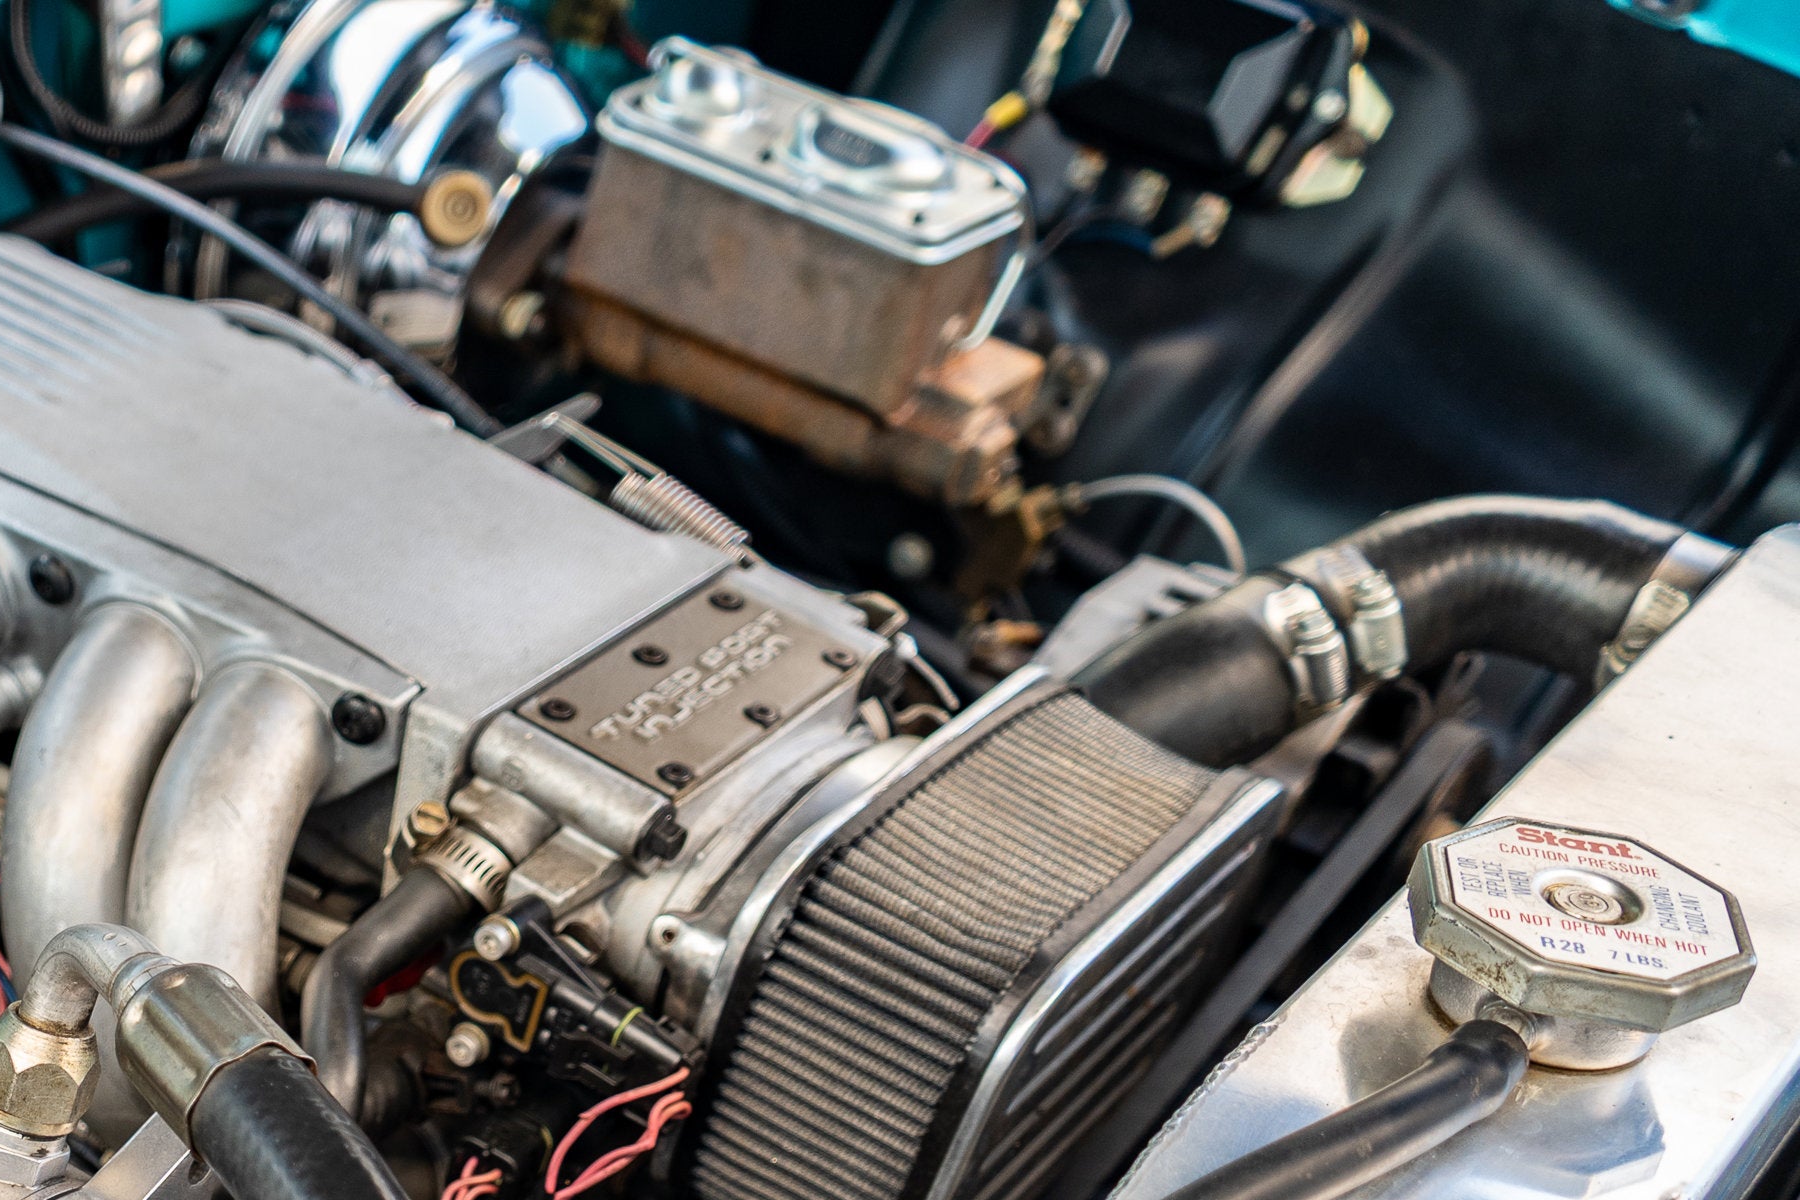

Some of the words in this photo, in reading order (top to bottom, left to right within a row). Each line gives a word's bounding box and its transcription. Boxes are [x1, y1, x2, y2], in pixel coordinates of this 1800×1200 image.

[589, 665, 703, 742] TUNED
[1499, 842, 1570, 863] CAUTION
[1577, 855, 1661, 879] PRESSURE
[1515, 827, 1633, 859] Stant
[1457, 857, 1479, 869] OR
[1460, 870, 1483, 893] TEST
[1482, 860, 1509, 899] REPLACE
[1508, 869, 1532, 895] WHEN
[1488, 907, 1511, 920] DO
[1520, 912, 1552, 928] NOT
[1561, 919, 1606, 937] OPEN
[1614, 928, 1667, 949] WHEN
[1675, 940, 1708, 956] HOT
[1678, 892, 1709, 935] COOLANT
